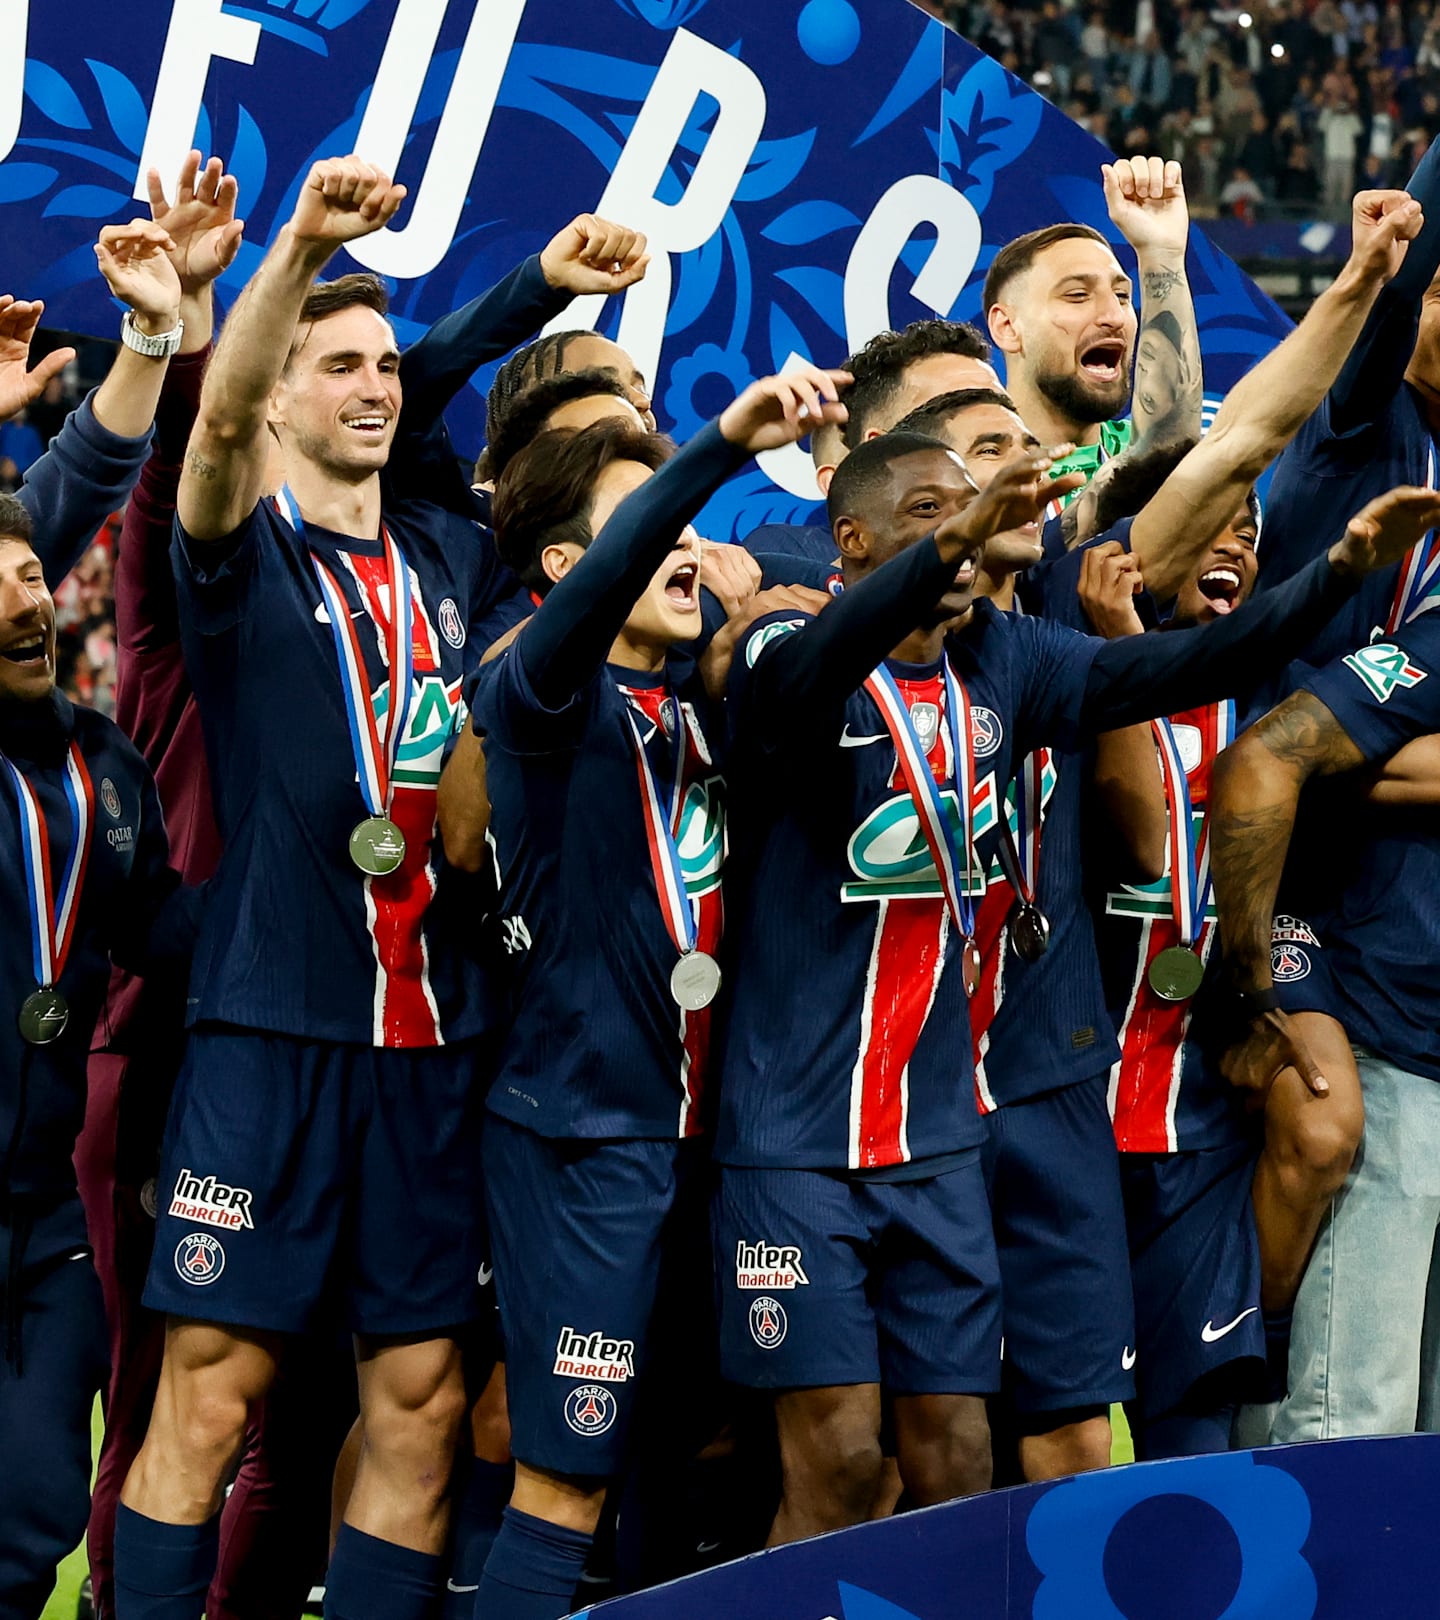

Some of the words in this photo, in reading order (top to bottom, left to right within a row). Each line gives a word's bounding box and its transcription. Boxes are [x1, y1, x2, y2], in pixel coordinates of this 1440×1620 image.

[107, 826, 133, 846] QATAR
[185, 1236, 218, 1252] PARIS
[753, 1299, 779, 1313] PARIS
[575, 1387, 609, 1402] PARIS
